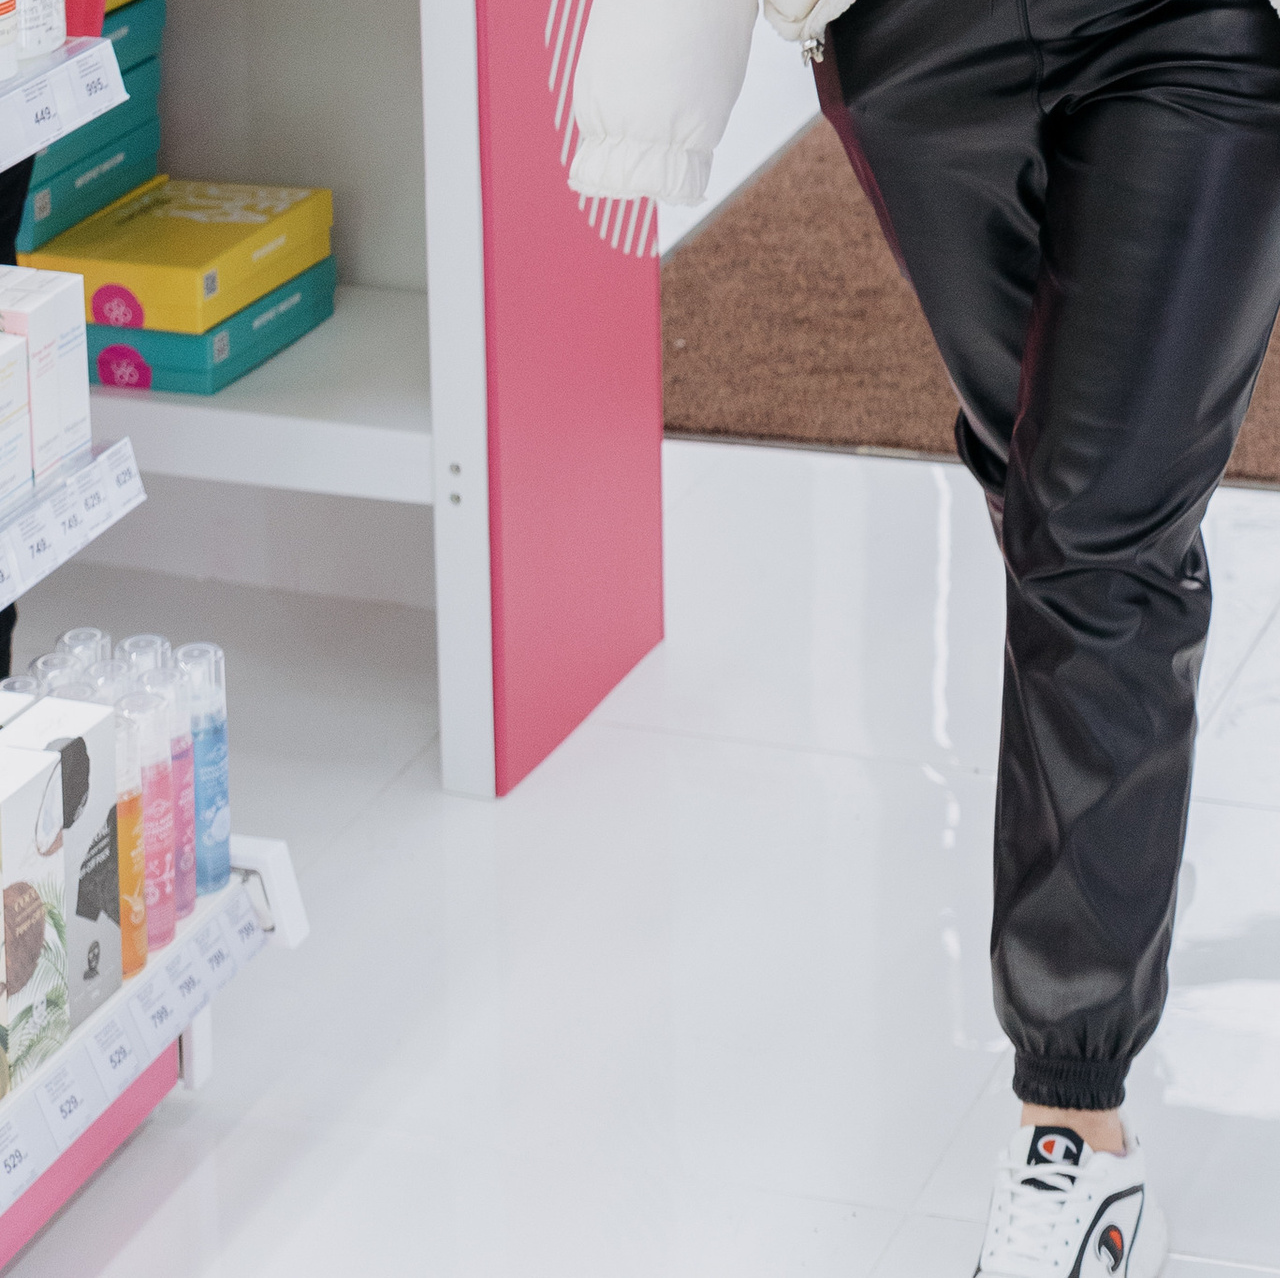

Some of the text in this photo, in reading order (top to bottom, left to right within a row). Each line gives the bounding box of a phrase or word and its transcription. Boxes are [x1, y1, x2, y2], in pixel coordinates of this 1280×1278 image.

[109, 1045, 128, 1070] 529
[59, 1095, 79, 1120] 529
[3, 1149, 23, 1174] 529
